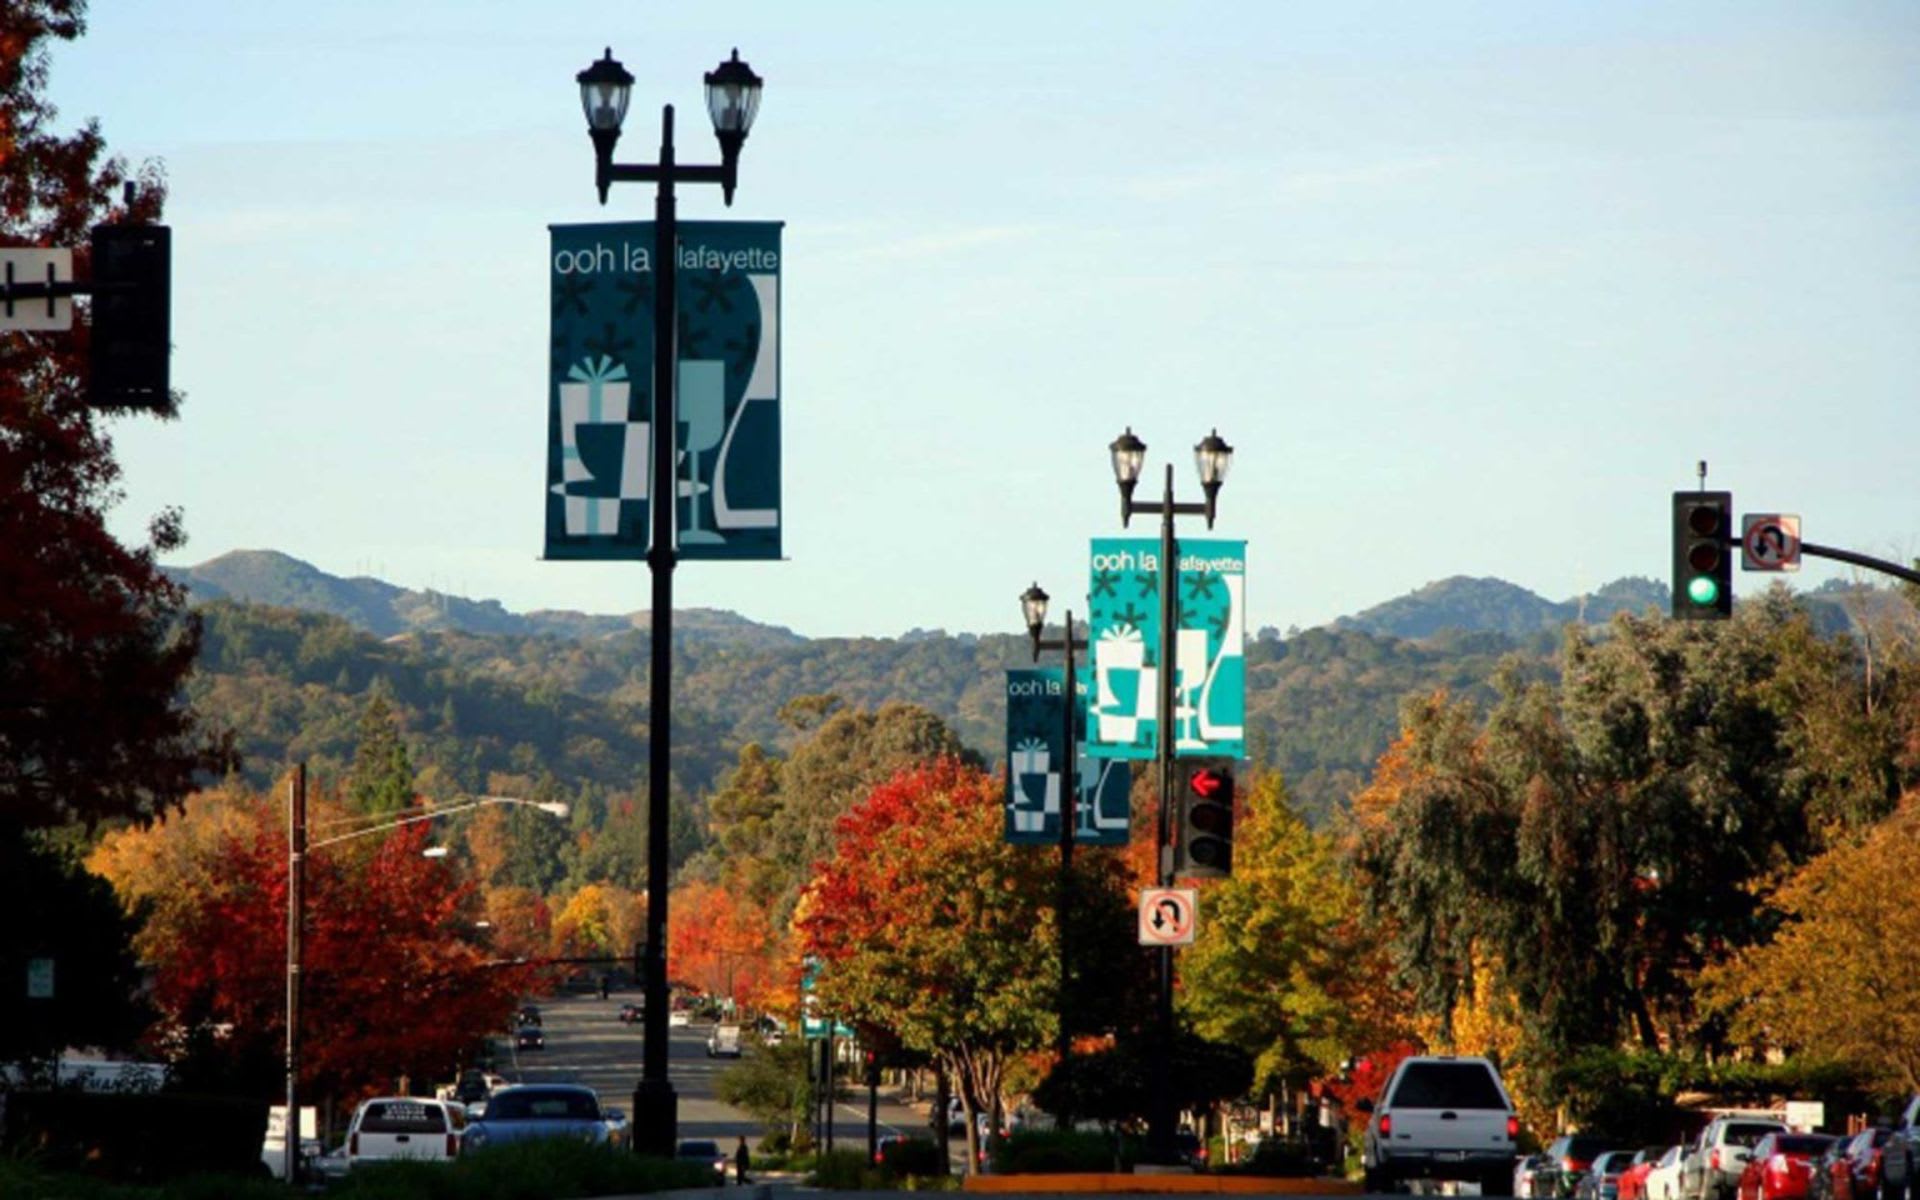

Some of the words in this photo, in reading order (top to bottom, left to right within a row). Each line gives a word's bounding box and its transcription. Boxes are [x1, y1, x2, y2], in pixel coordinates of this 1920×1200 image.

[554, 242, 615, 274] ooh
[623, 241, 651, 273] la
[678, 244, 778, 274] lafayette
[1093, 550, 1135, 571] ooh
[1139, 550, 1158, 571] la
[1178, 555, 1243, 575] afayette
[1009, 679, 1043, 696] ooh
[1046, 679, 1061, 696] la
